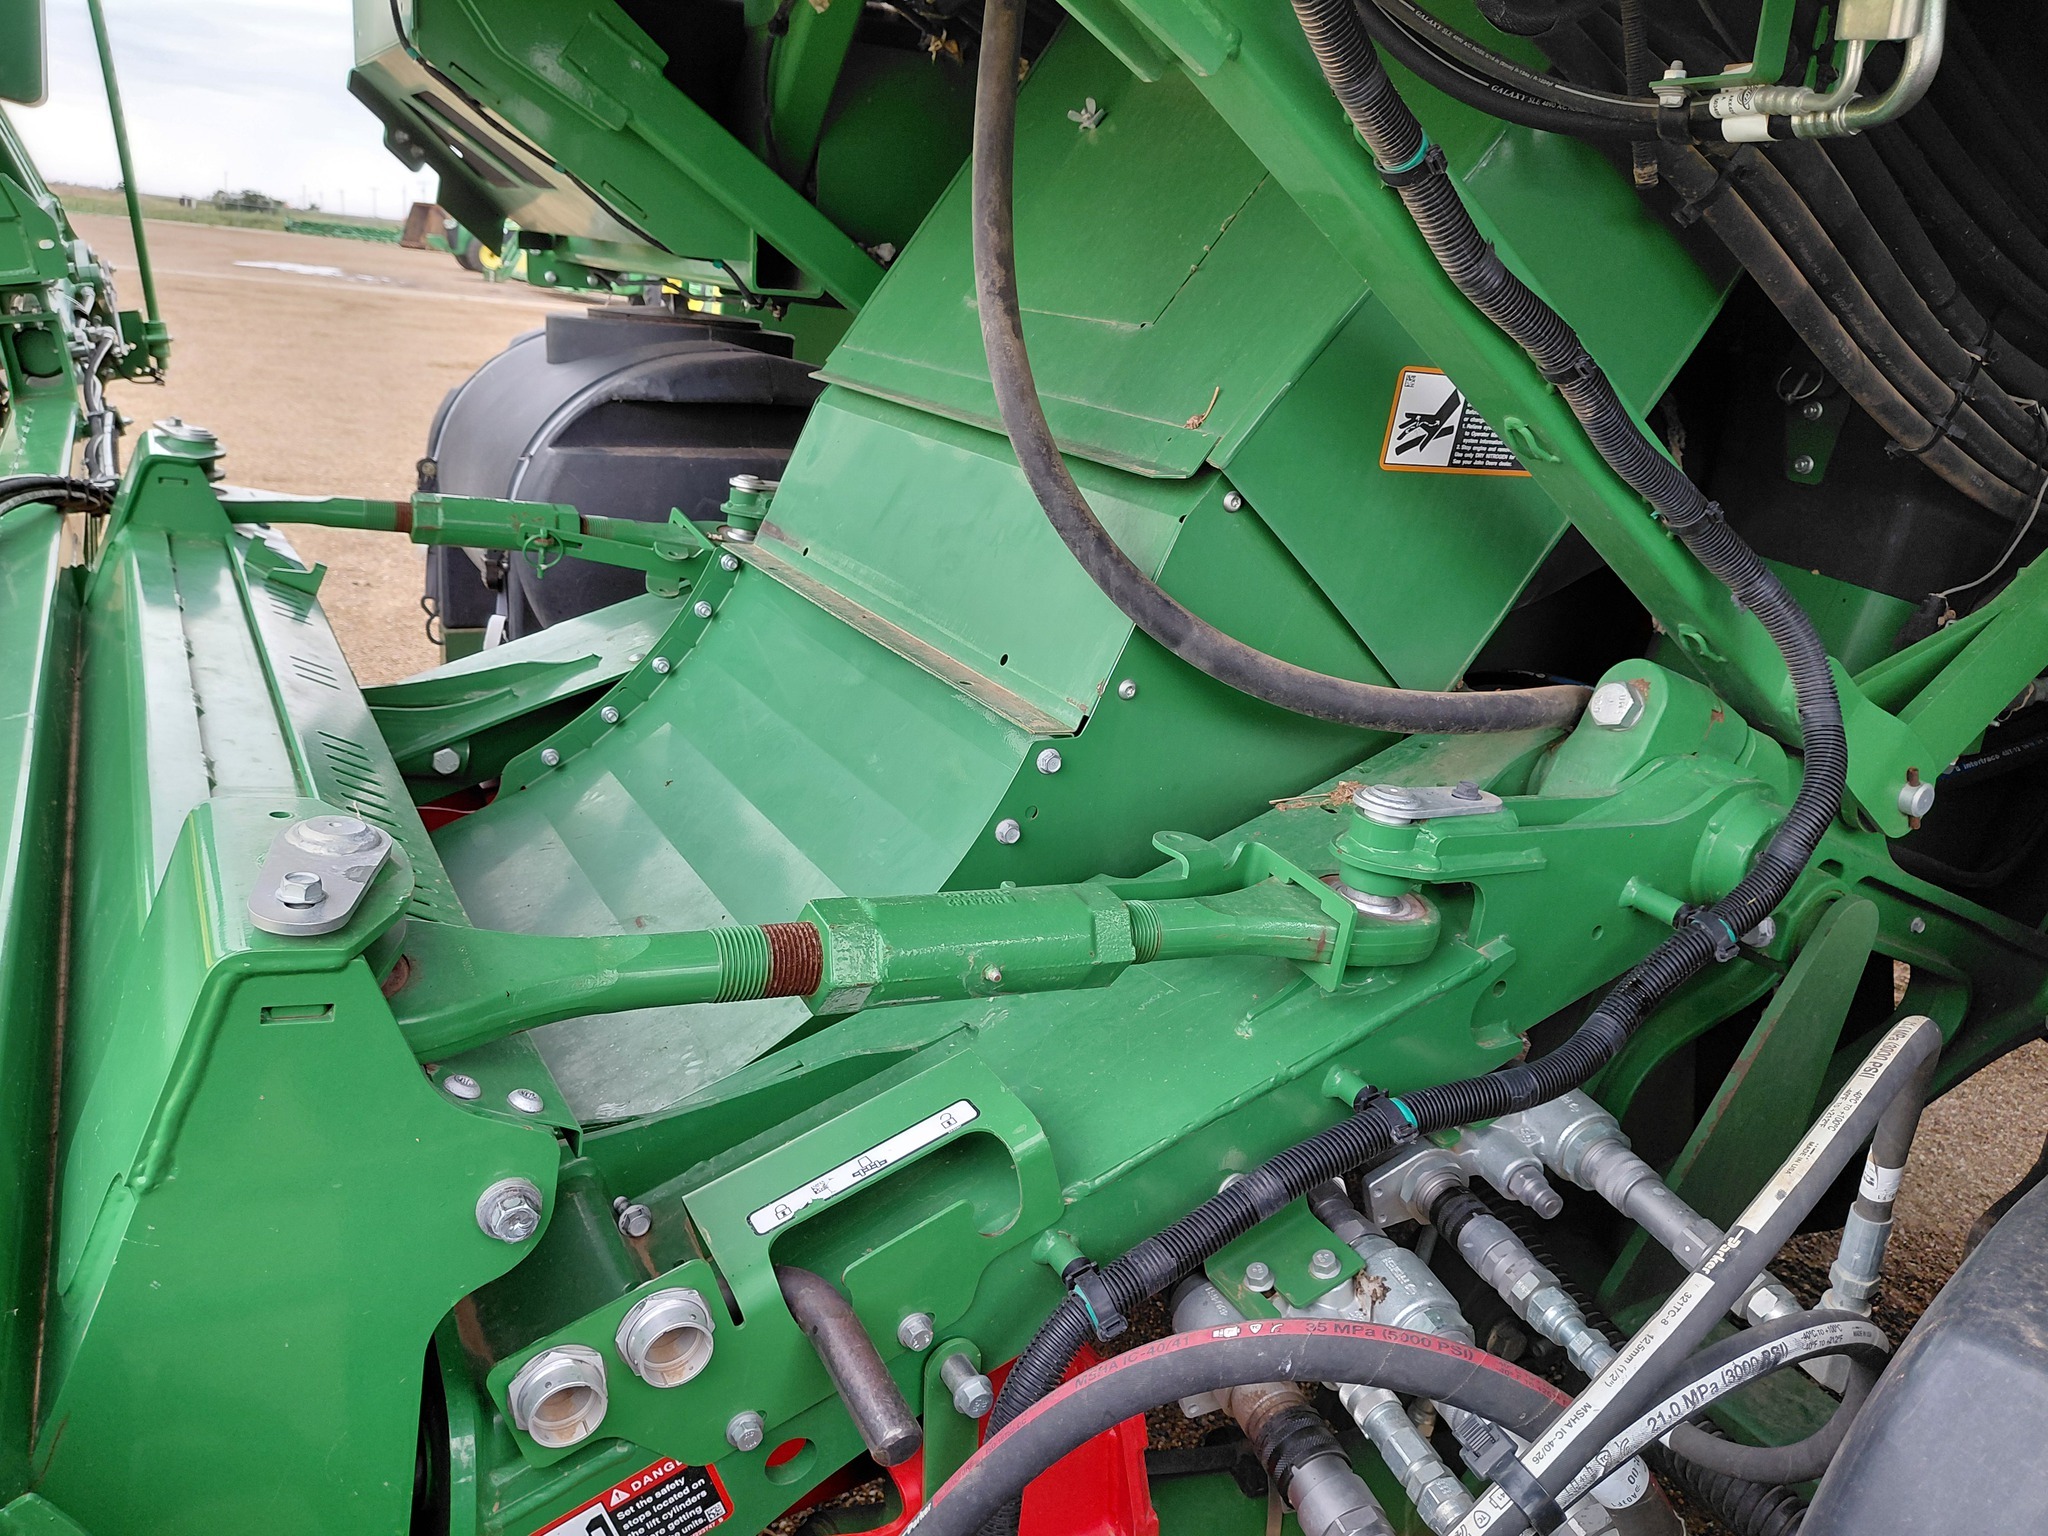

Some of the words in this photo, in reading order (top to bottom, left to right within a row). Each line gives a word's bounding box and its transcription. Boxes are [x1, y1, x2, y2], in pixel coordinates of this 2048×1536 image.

[1415, 10, 1442, 30] GALAXY
[1491, 85, 1527, 102] GALAXY
[1800, 1141, 1815, 1156] MADE
[1702, 1229, 1745, 1275] Parker
[1660, 1291, 1692, 1326] 321TC-8
[1075, 1360, 1118, 1389] MSHA
[1122, 1336, 1190, 1364] IC-40/41
[1306, 1322, 1328, 1333] 35
[1333, 1323, 1376, 1337] MPa
[1382, 1326, 1432, 1348] (5000
[1437, 1340, 1474, 1361] PSI)
[1682, 1382, 1720, 1409] MPa
[1721, 1356, 1760, 1386] (3000
[1760, 1341, 1789, 1368] PSI)
[1565, 1402, 1592, 1429] MSHA
[1532, 1428, 1567, 1465] IC-40/26
[631, 1459, 682, 1492] DANG
[617, 1505, 635, 1520] Set
[636, 1496, 653, 1509] the
[655, 1476, 685, 1498] safety
[623, 1510, 651, 1530] stops
[652, 1486, 690, 1512] located
[692, 1479, 705, 1490] on
[646, 1517, 660, 1530] lift
[662, 1490, 707, 1520] cylinders
[667, 1505, 703, 1531] getting
[681, 1517, 706, 1534] units.
[1477, 1514, 1487, 1524] TC
